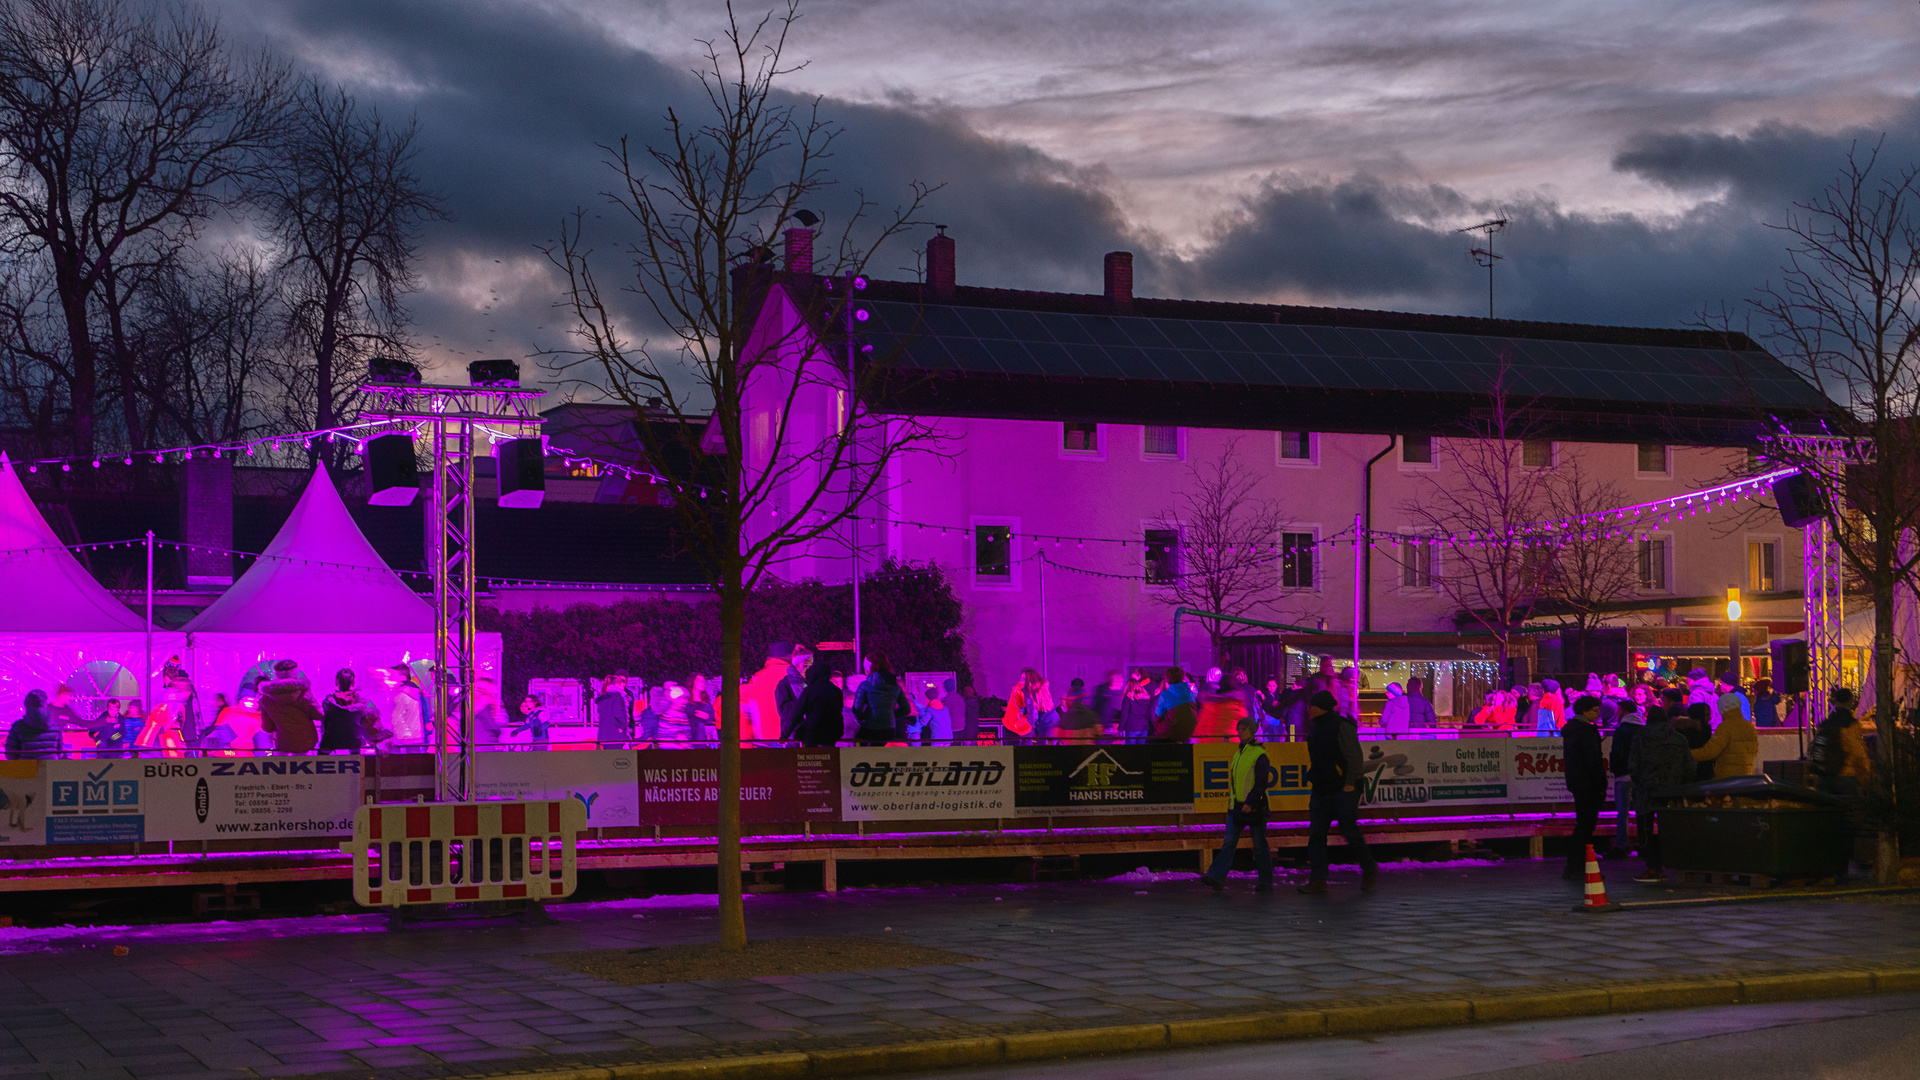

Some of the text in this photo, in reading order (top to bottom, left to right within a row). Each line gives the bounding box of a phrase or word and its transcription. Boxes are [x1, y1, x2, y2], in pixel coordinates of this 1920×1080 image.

[1456, 747, 1500, 759] Gute Ideen
[144, 760, 361, 778] BÜRO ZANKER
[850, 761, 1005, 787] OBERLAND
[1427, 760, 1501, 774] für Ihre Baustelle!
[644, 768, 718, 783] WAS IST DEIN
[1203, 761, 1229, 790] E
[197, 785, 208, 816] GmbH
[256, 791, 289, 799] Penzberg
[645, 786, 773, 803] NÄCHSTES ABEUER?
[1069, 789, 1144, 801] HANSI FISCHER
[851, 800, 1003, 811] www.oberland-logistik.de
[215, 818, 354, 833] www.zankershop.de
